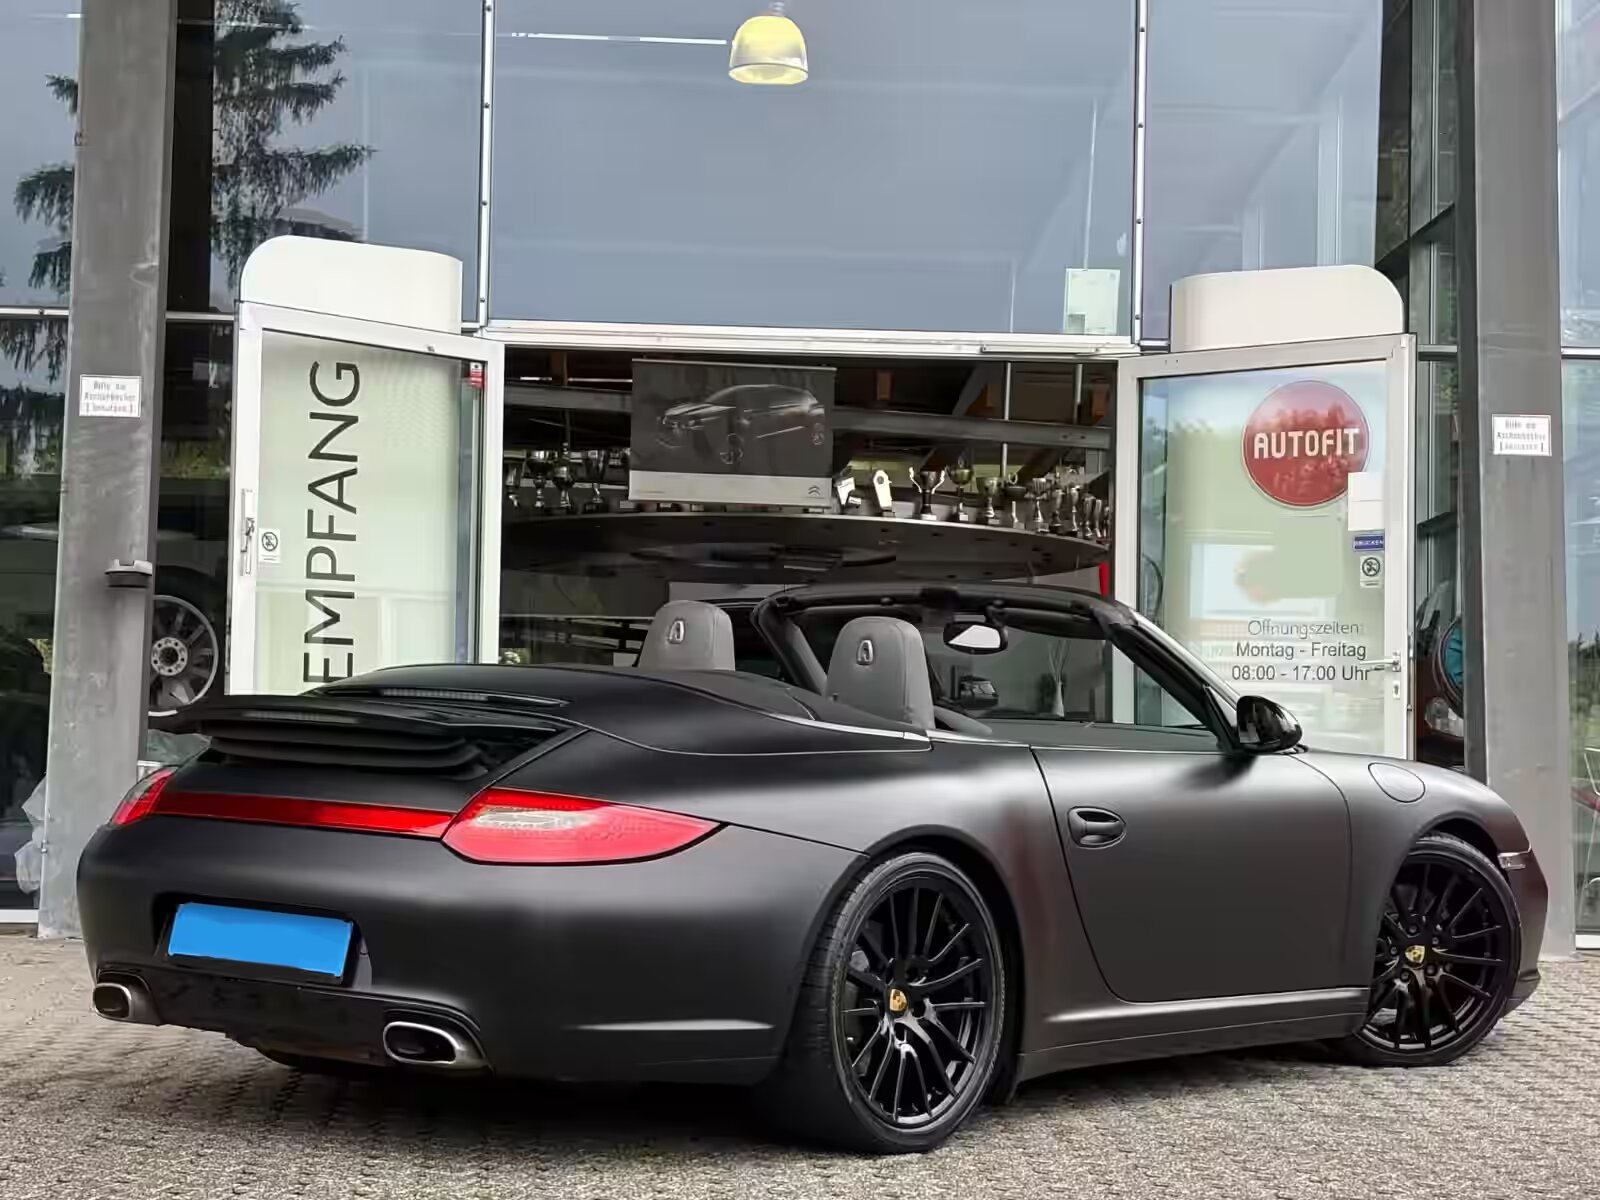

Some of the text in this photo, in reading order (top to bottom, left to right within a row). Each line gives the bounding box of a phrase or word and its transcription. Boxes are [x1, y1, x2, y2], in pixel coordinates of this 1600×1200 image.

[1253, 427, 1361, 460] AUTOFIT
[303, 360, 361, 683] EMPFANG
[1236, 642, 1295, 661] Montag
[1311, 641, 1367, 661] Freitag
[1232, 665, 1276, 681] 08:00
[1293, 665, 1336, 681] 17:00
[1342, 665, 1370, 681] Uhr
